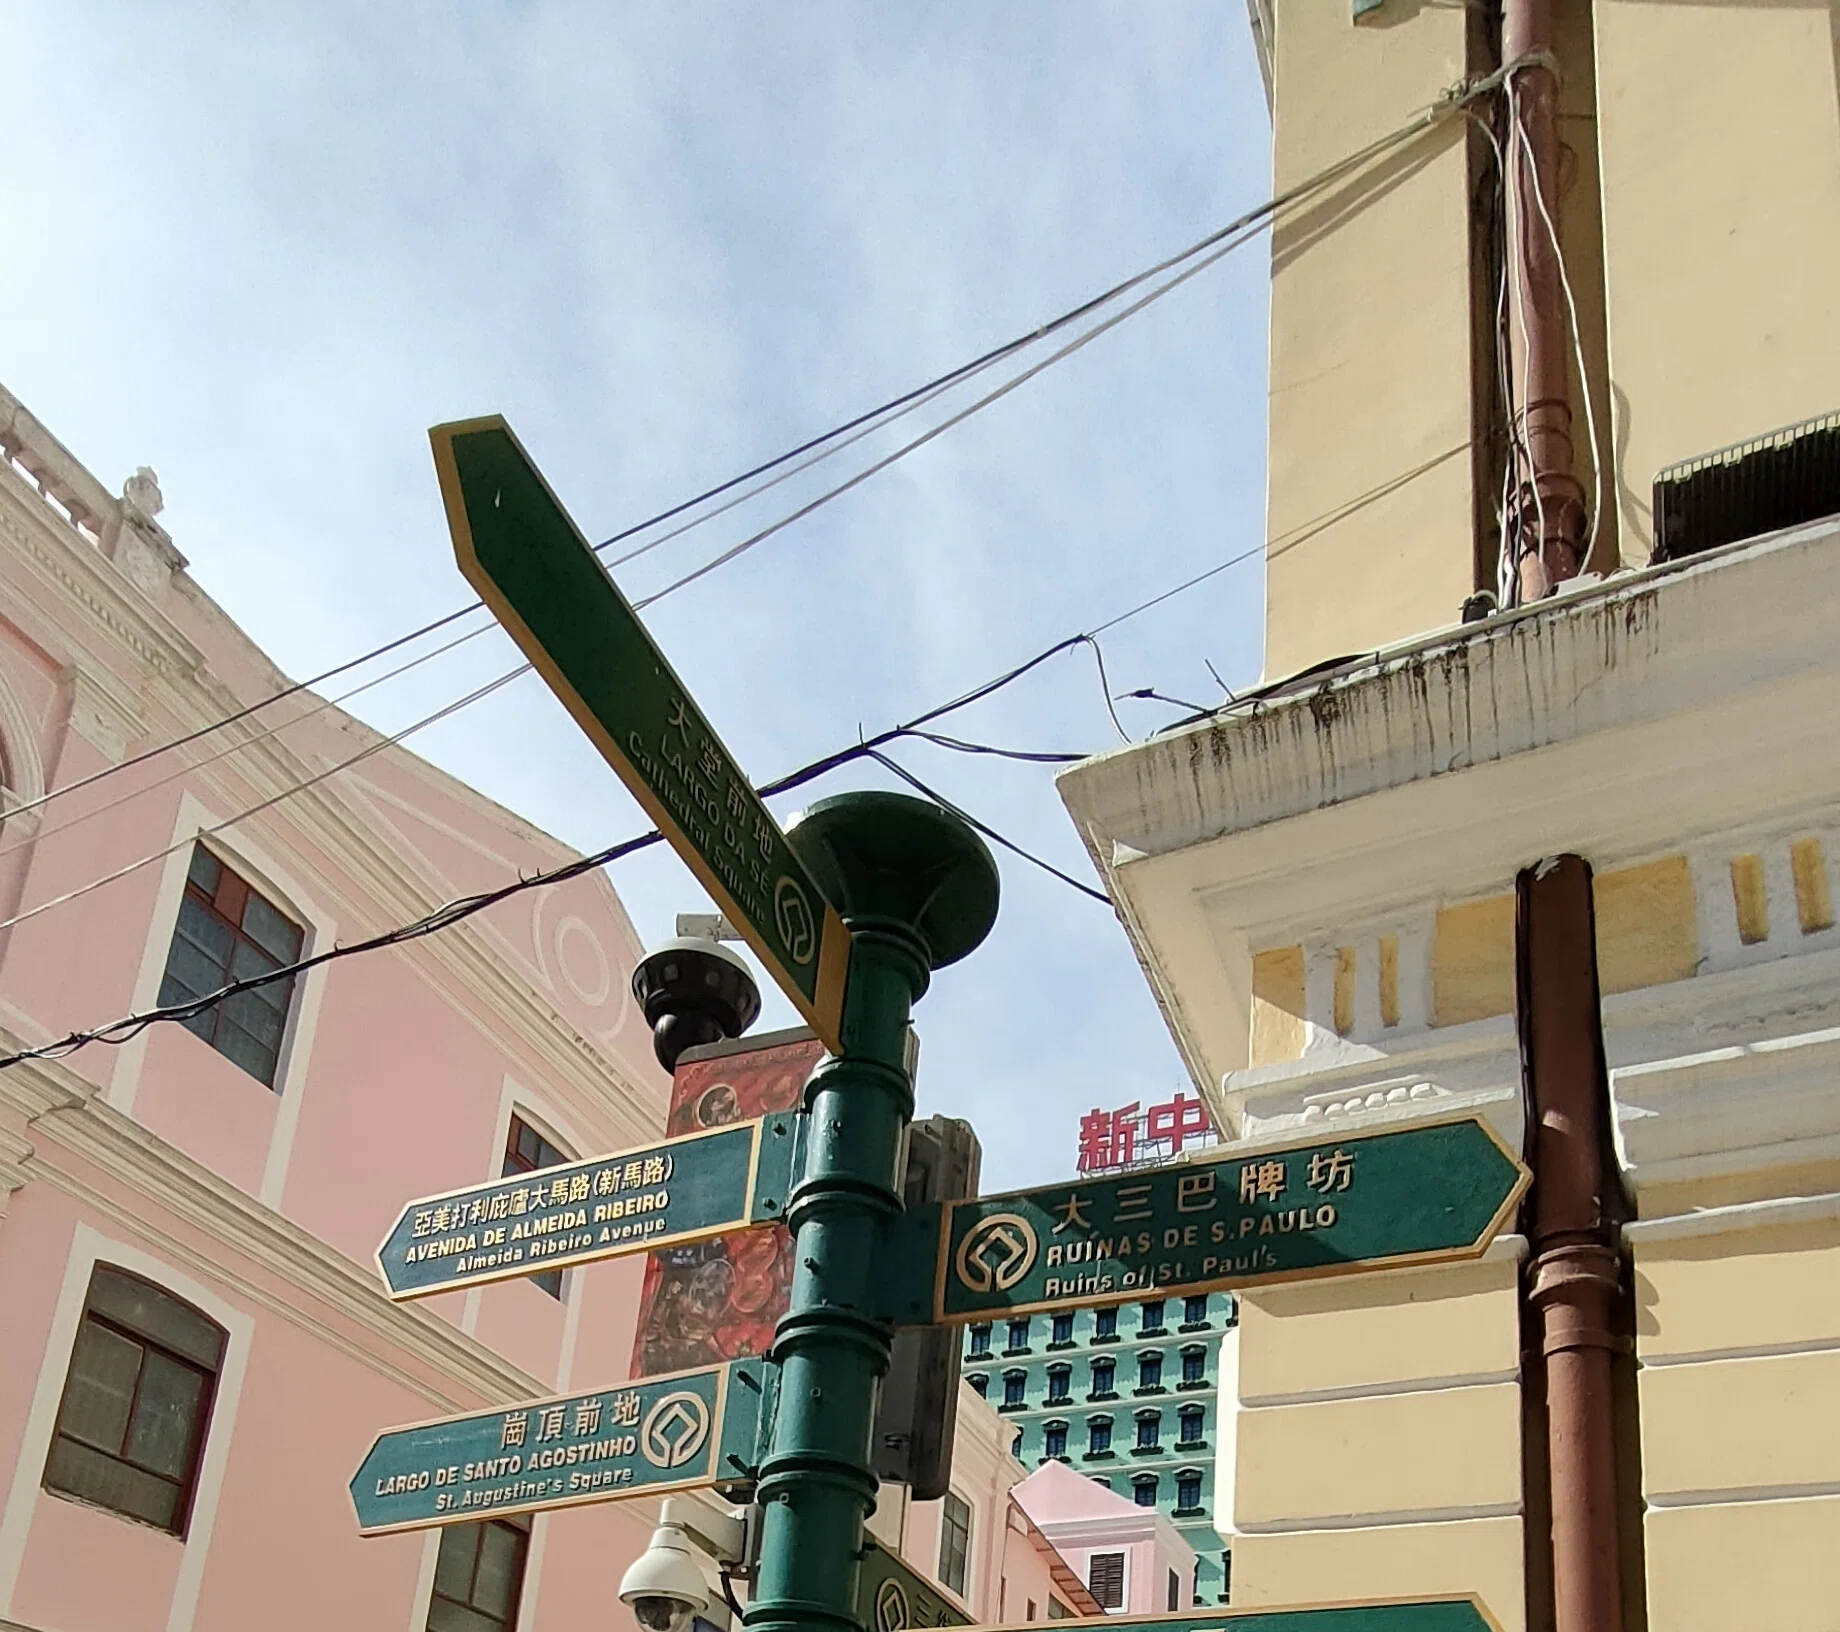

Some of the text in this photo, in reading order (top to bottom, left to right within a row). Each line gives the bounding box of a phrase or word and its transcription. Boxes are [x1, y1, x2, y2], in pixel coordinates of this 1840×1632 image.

[661, 734, 720, 826] LARGO
[724, 821, 745, 865] DA
[668, 697, 773, 864] 大堂前地
[629, 731, 765, 925] Cathedral Square
[1077, 1093, 1209, 1171] 新中
[1051, 1149, 1354, 1234] 大三巴牌坊
[404, 1190, 670, 1264] AVENIDA DE ALMEIDA RIBEIRO
[456, 1218, 666, 1273] Almeida Ribeiro Avenue
[1164, 1225, 1198, 1249] DE
[1211, 1204, 1336, 1243] S.PAULO
[1045, 1245, 1277, 1298] Ruins of St. Paul's
[501, 1391, 641, 1450] 崗頂前地
[374, 1436, 636, 1498] LARGO DE SANTO AGOSTINHO
[435, 1467, 633, 1511] St. Augustine's Square
